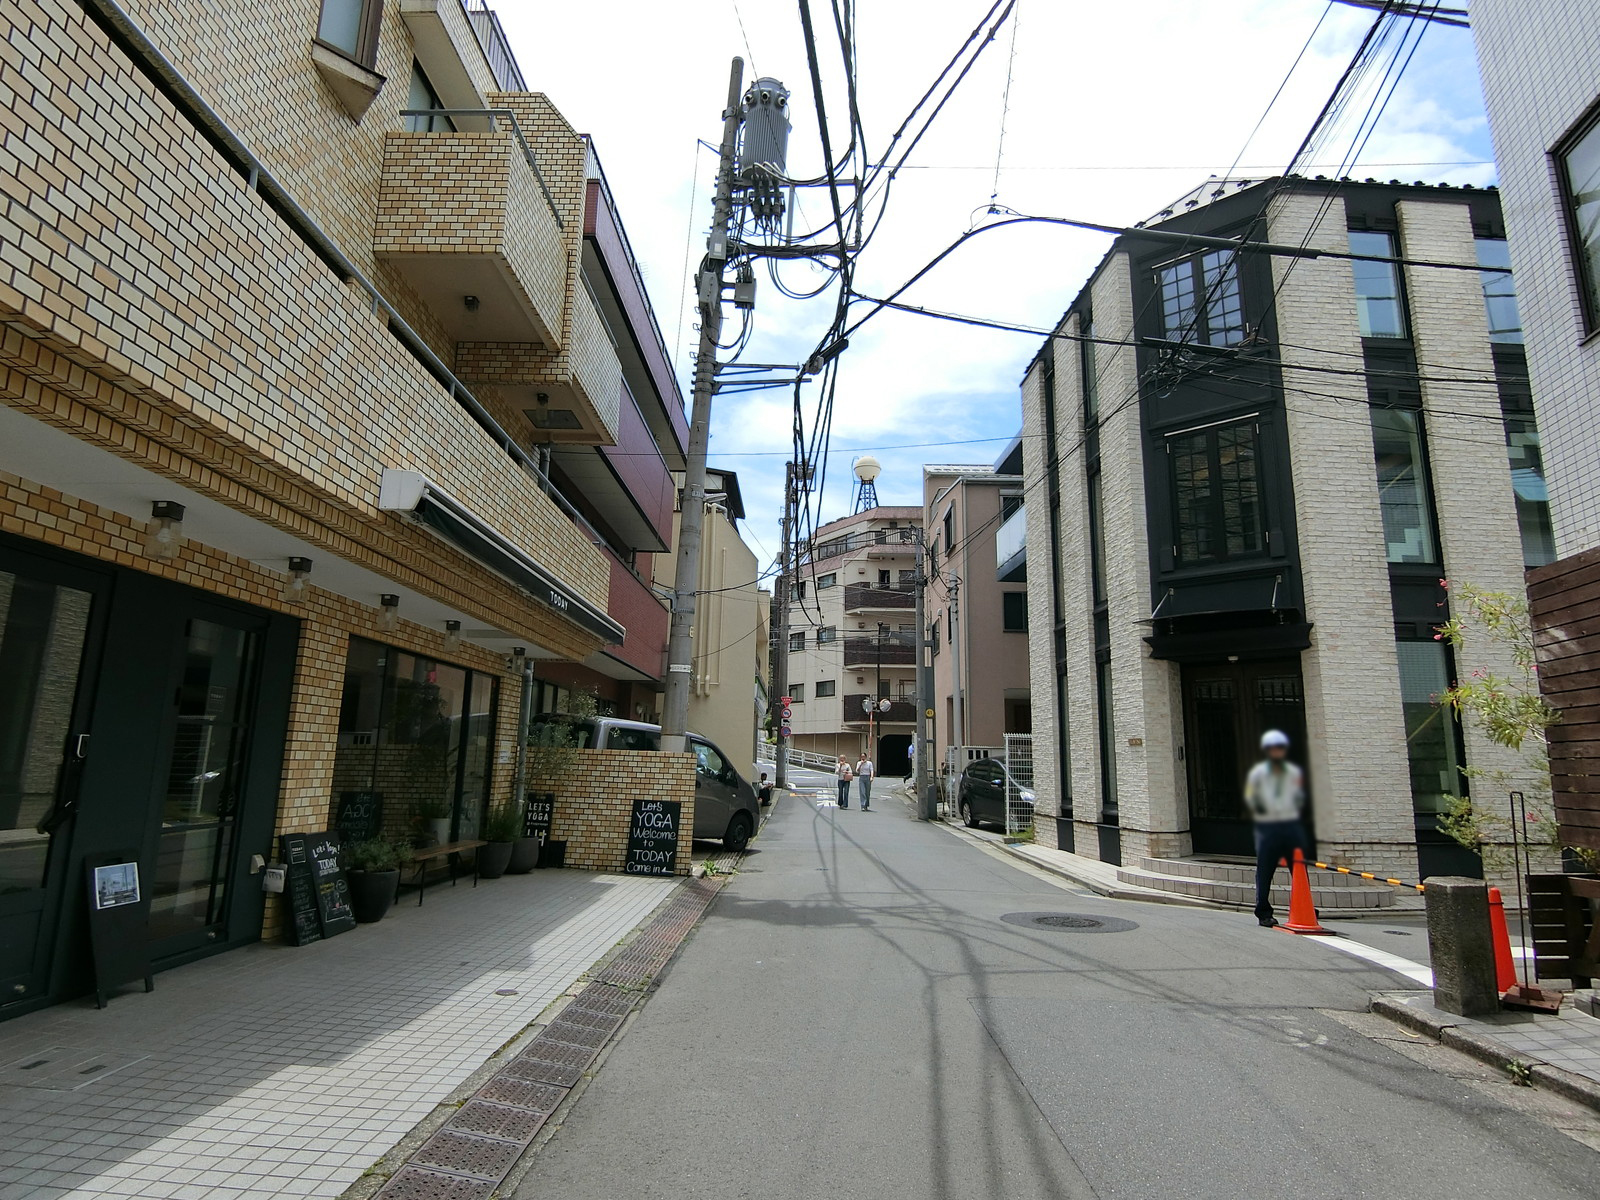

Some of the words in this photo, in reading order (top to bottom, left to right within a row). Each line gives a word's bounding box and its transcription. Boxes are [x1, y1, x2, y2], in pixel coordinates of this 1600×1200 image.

[550, 590, 568, 611] TODAY
[528, 802, 551, 811] LET'S
[527, 812, 549, 821] YOGA
[636, 811, 673, 829] YOGA
[633, 827, 677, 840] Welcome
[642, 839, 655, 847] to
[633, 849, 673, 863] TODAY
[317, 856, 337, 870] TODAY
[626, 861, 652, 873] Come
[652, 864, 661, 873] in
